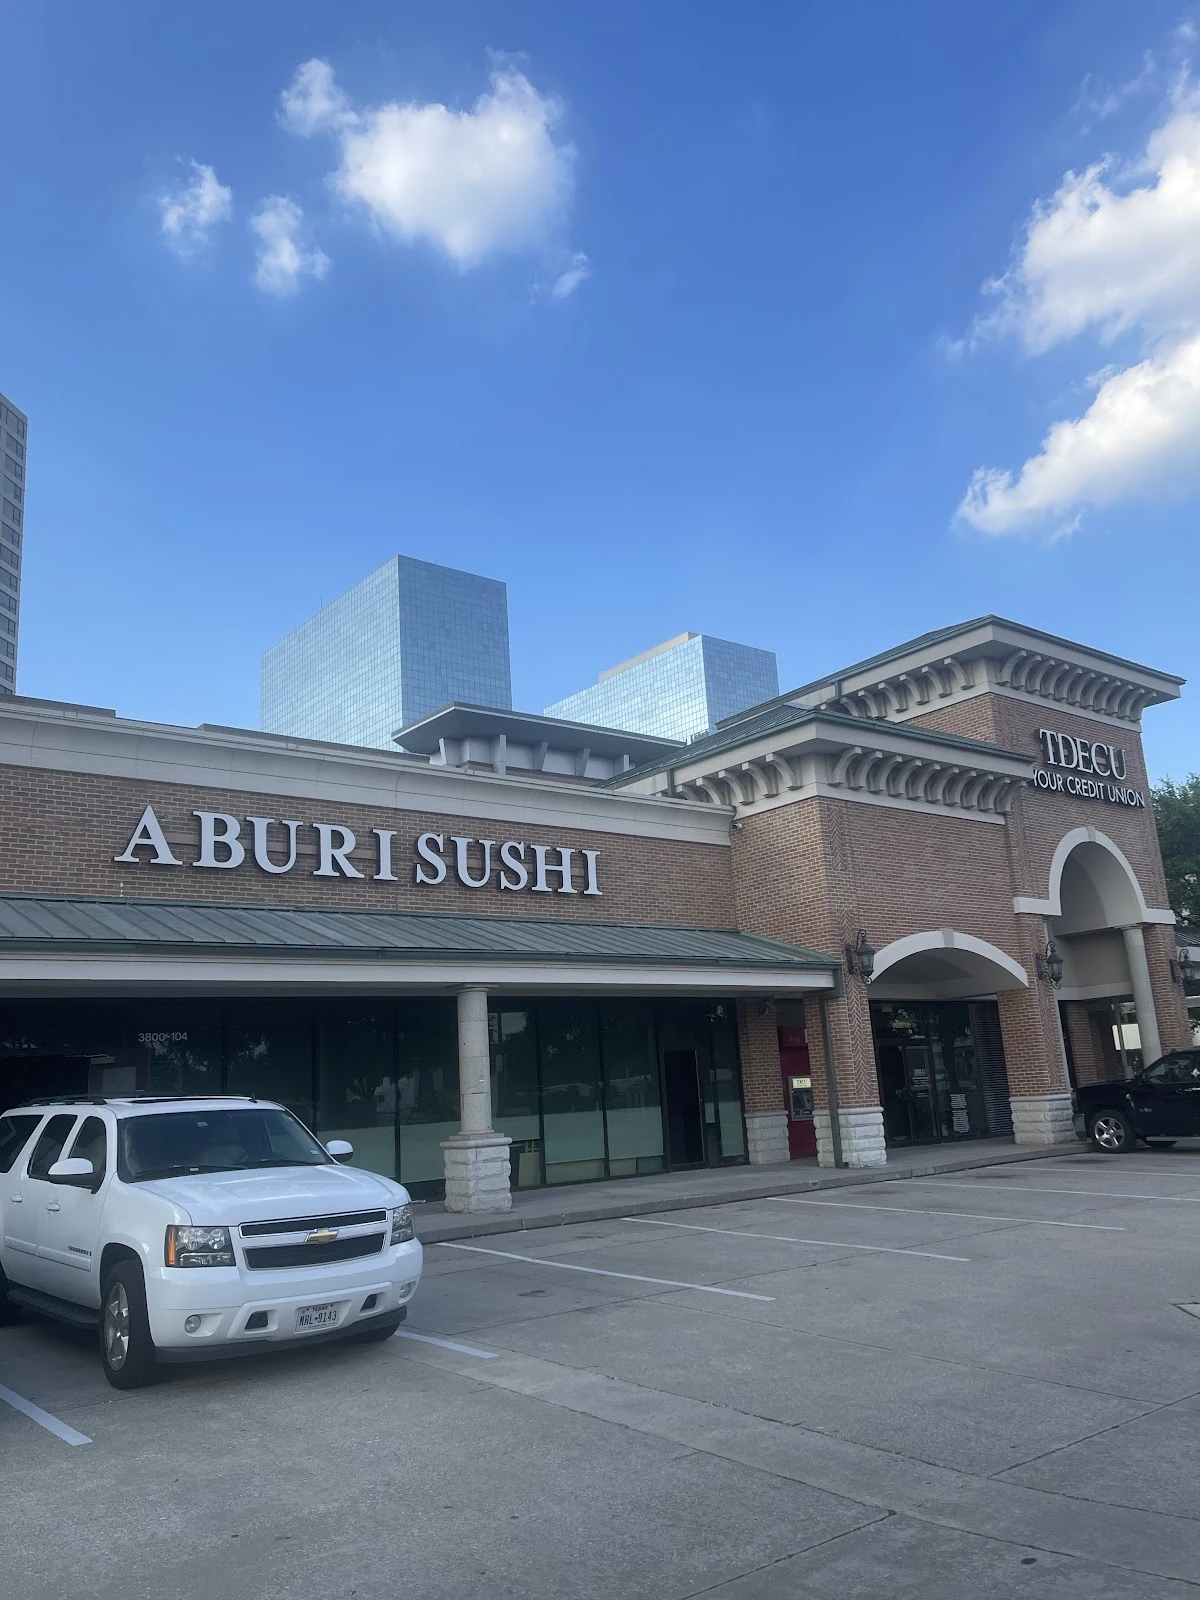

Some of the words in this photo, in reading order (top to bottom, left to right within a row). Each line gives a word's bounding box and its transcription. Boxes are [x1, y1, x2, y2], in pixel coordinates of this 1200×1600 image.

[1037, 728, 1127, 781] TDECU
[1032, 769, 1065, 792] YOUR
[1066, 776, 1105, 800] CREDIT
[1107, 784, 1145, 808] UNION
[113, 804, 399, 881] ABURI
[415, 832, 604, 896] SUSHI
[138, 1032, 189, 1042] 3800-104
